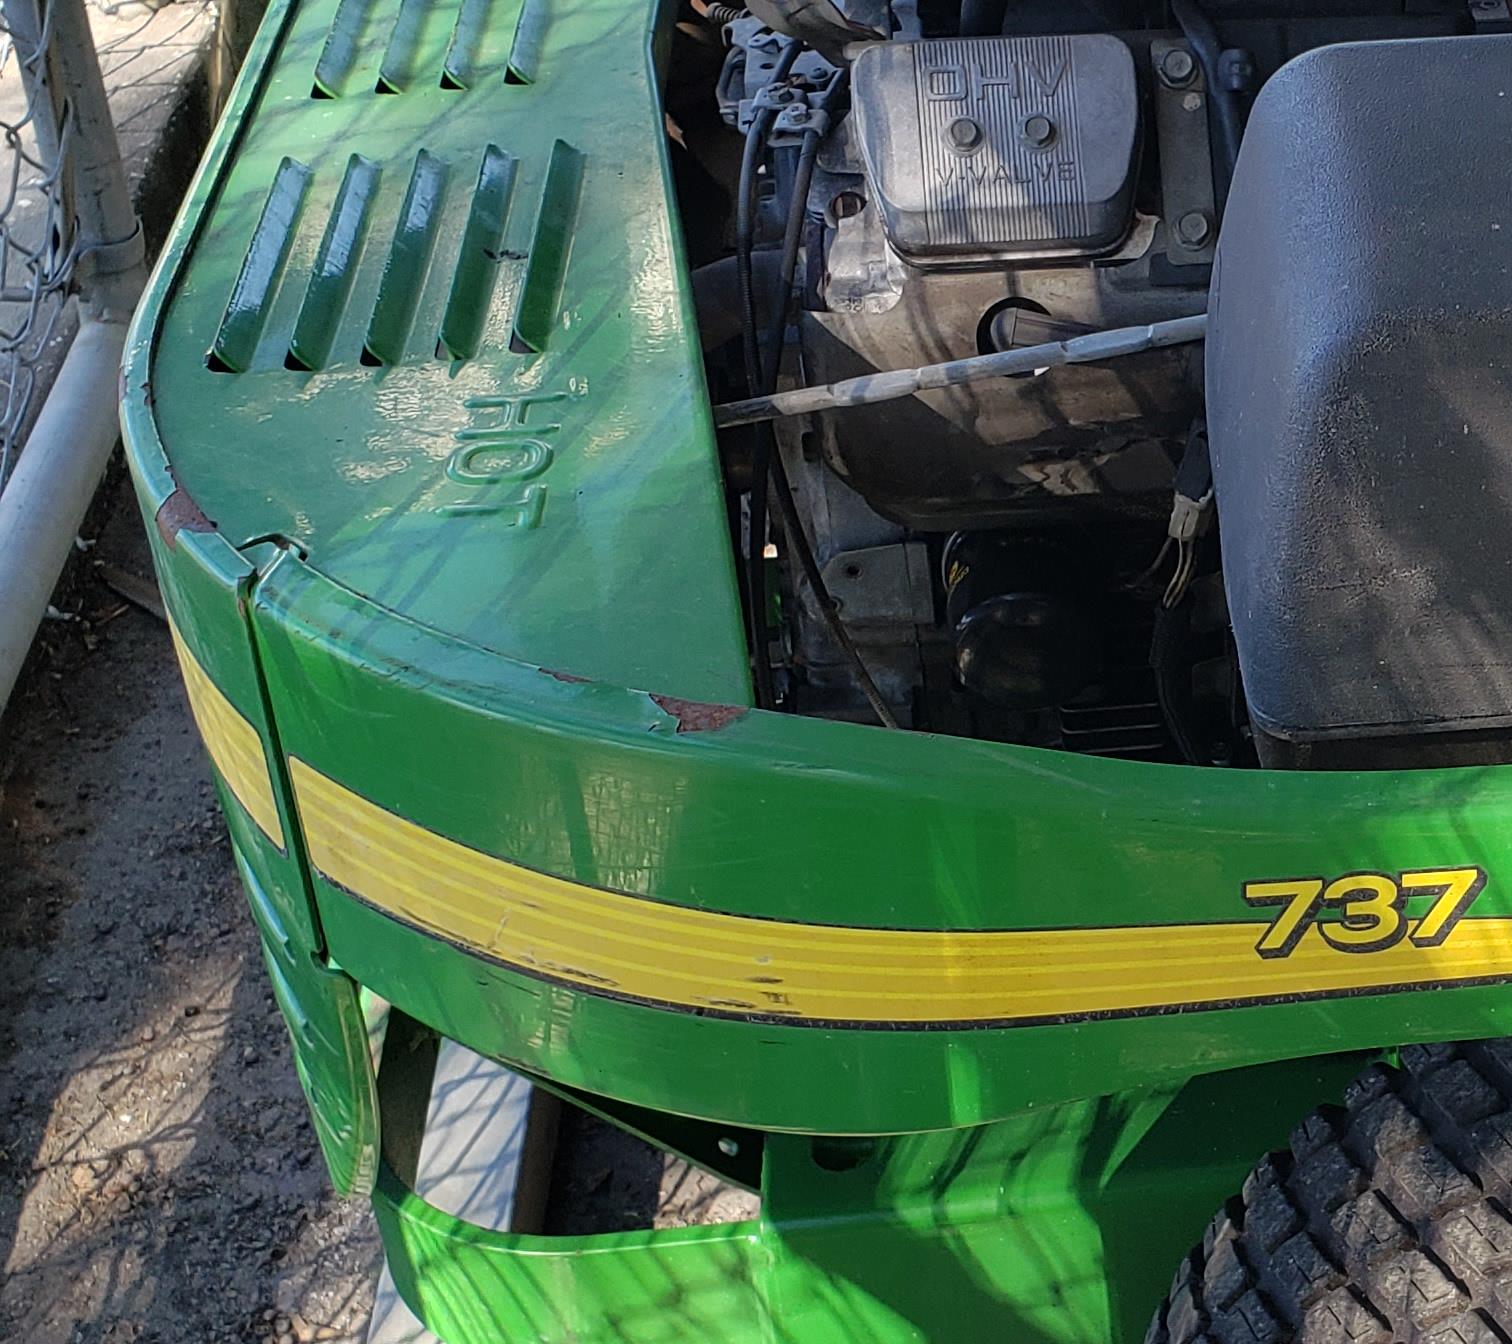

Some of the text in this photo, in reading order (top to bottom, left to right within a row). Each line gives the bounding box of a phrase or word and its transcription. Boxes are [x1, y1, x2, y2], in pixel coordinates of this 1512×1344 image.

[923, 59, 1070, 102] OHV
[936, 161, 1075, 187] V-VALVE
[435, 391, 568, 529] HOT
[1241, 864, 1488, 960] 737
